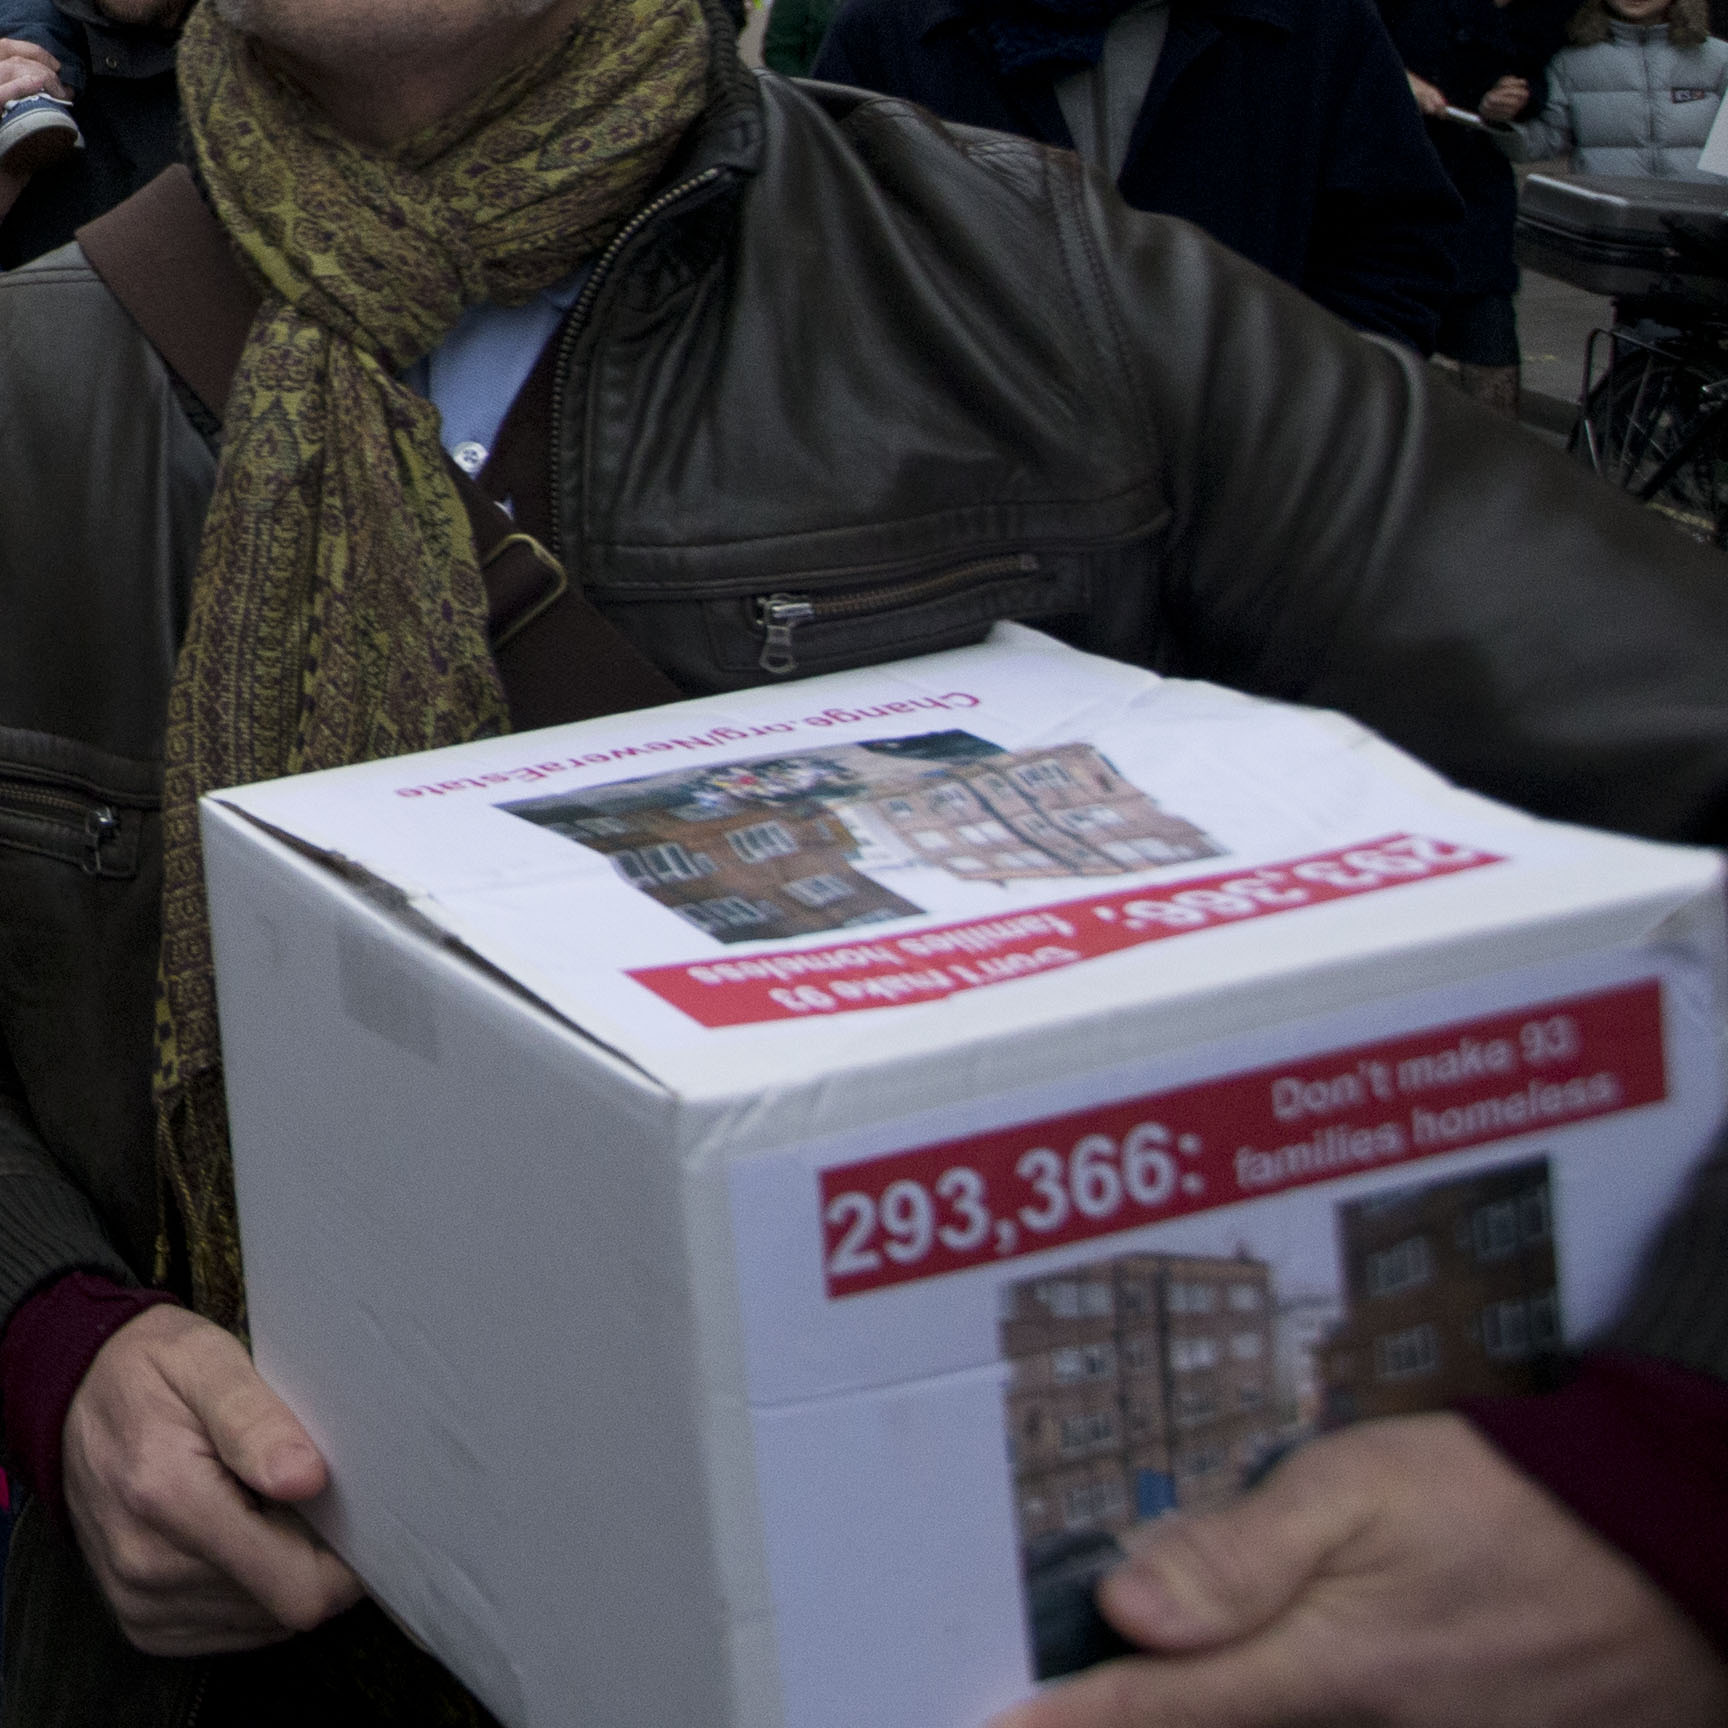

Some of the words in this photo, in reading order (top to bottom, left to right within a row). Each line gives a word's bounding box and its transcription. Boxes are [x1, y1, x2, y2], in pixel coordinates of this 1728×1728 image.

[896, 911, 1076, 958] families
[687, 942, 907, 986] homeless
[829, 967, 953, 1002] make
[768, 983, 837, 1013] 93
[1271, 1059, 1393, 1122] Don't
[1397, 1035, 1516, 1091] make
[1518, 1014, 1580, 1064] 93
[1235, 1121, 1405, 1191] families
[1410, 1070, 1620, 1146] homeless
[826, 1120, 1204, 1273] 293,366:
